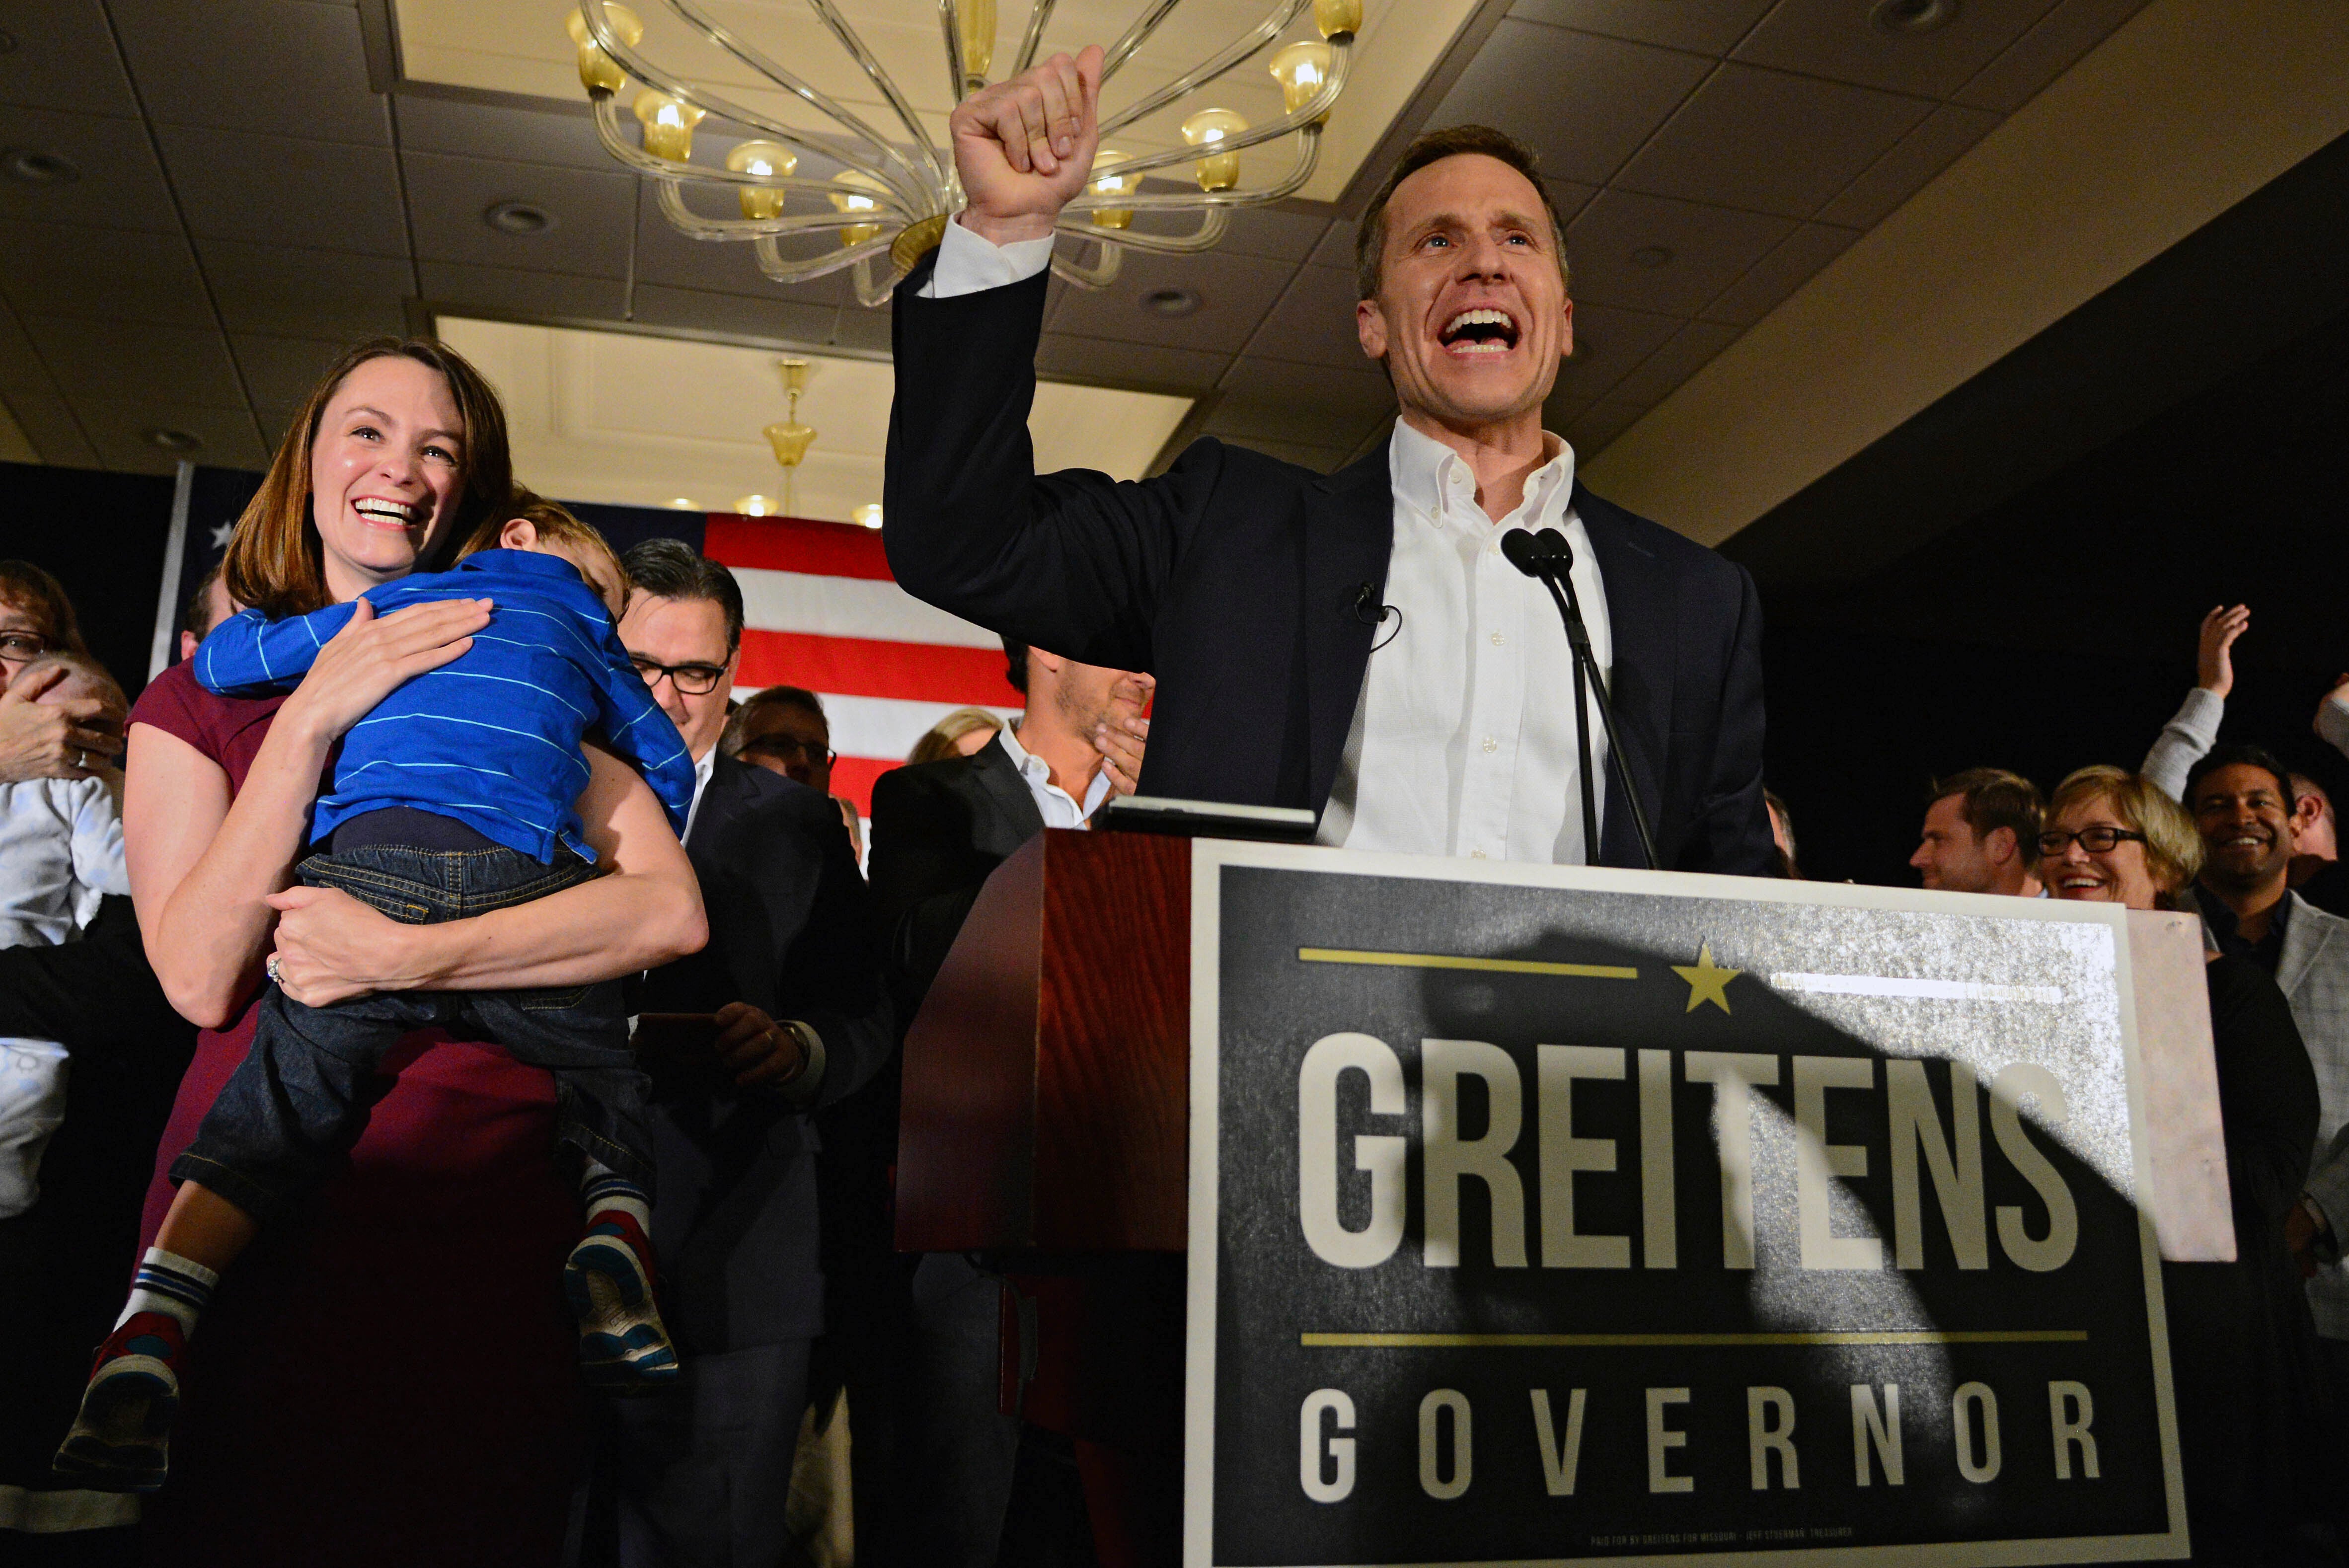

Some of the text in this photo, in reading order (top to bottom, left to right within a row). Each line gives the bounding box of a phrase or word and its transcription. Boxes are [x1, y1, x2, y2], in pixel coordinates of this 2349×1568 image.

[1299, 1032, 2079, 1272] GREITENS
[1299, 1380, 2101, 1504] GOVERNOR
[1591, 1535, 1609, 1546] PAID
[1612, 1535, 1627, 1545] FOR
[1630, 1534, 1639, 1545] BY
[1642, 1533, 1680, 1544] GREITENS
[1682, 1532, 1697, 1543] FOR
[1700, 1531, 1737, 1542] MISSOURI
